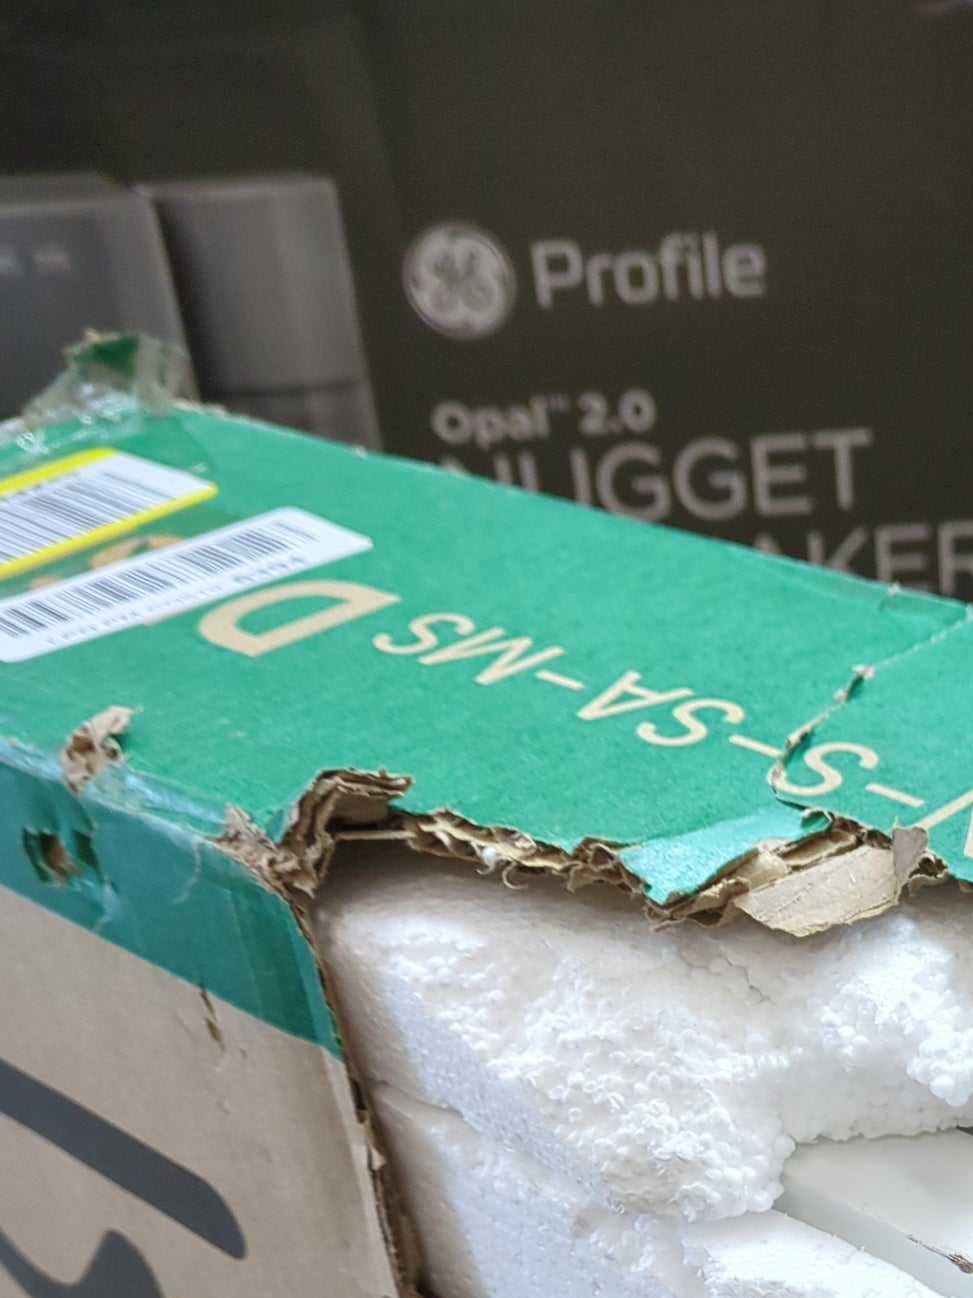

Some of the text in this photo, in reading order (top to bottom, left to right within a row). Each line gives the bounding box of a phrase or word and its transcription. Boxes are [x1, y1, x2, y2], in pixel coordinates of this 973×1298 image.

[530, 232, 767, 308] Profile
[577, 387, 656, 437] 2.0
[438, 427, 873, 523] UGGET
